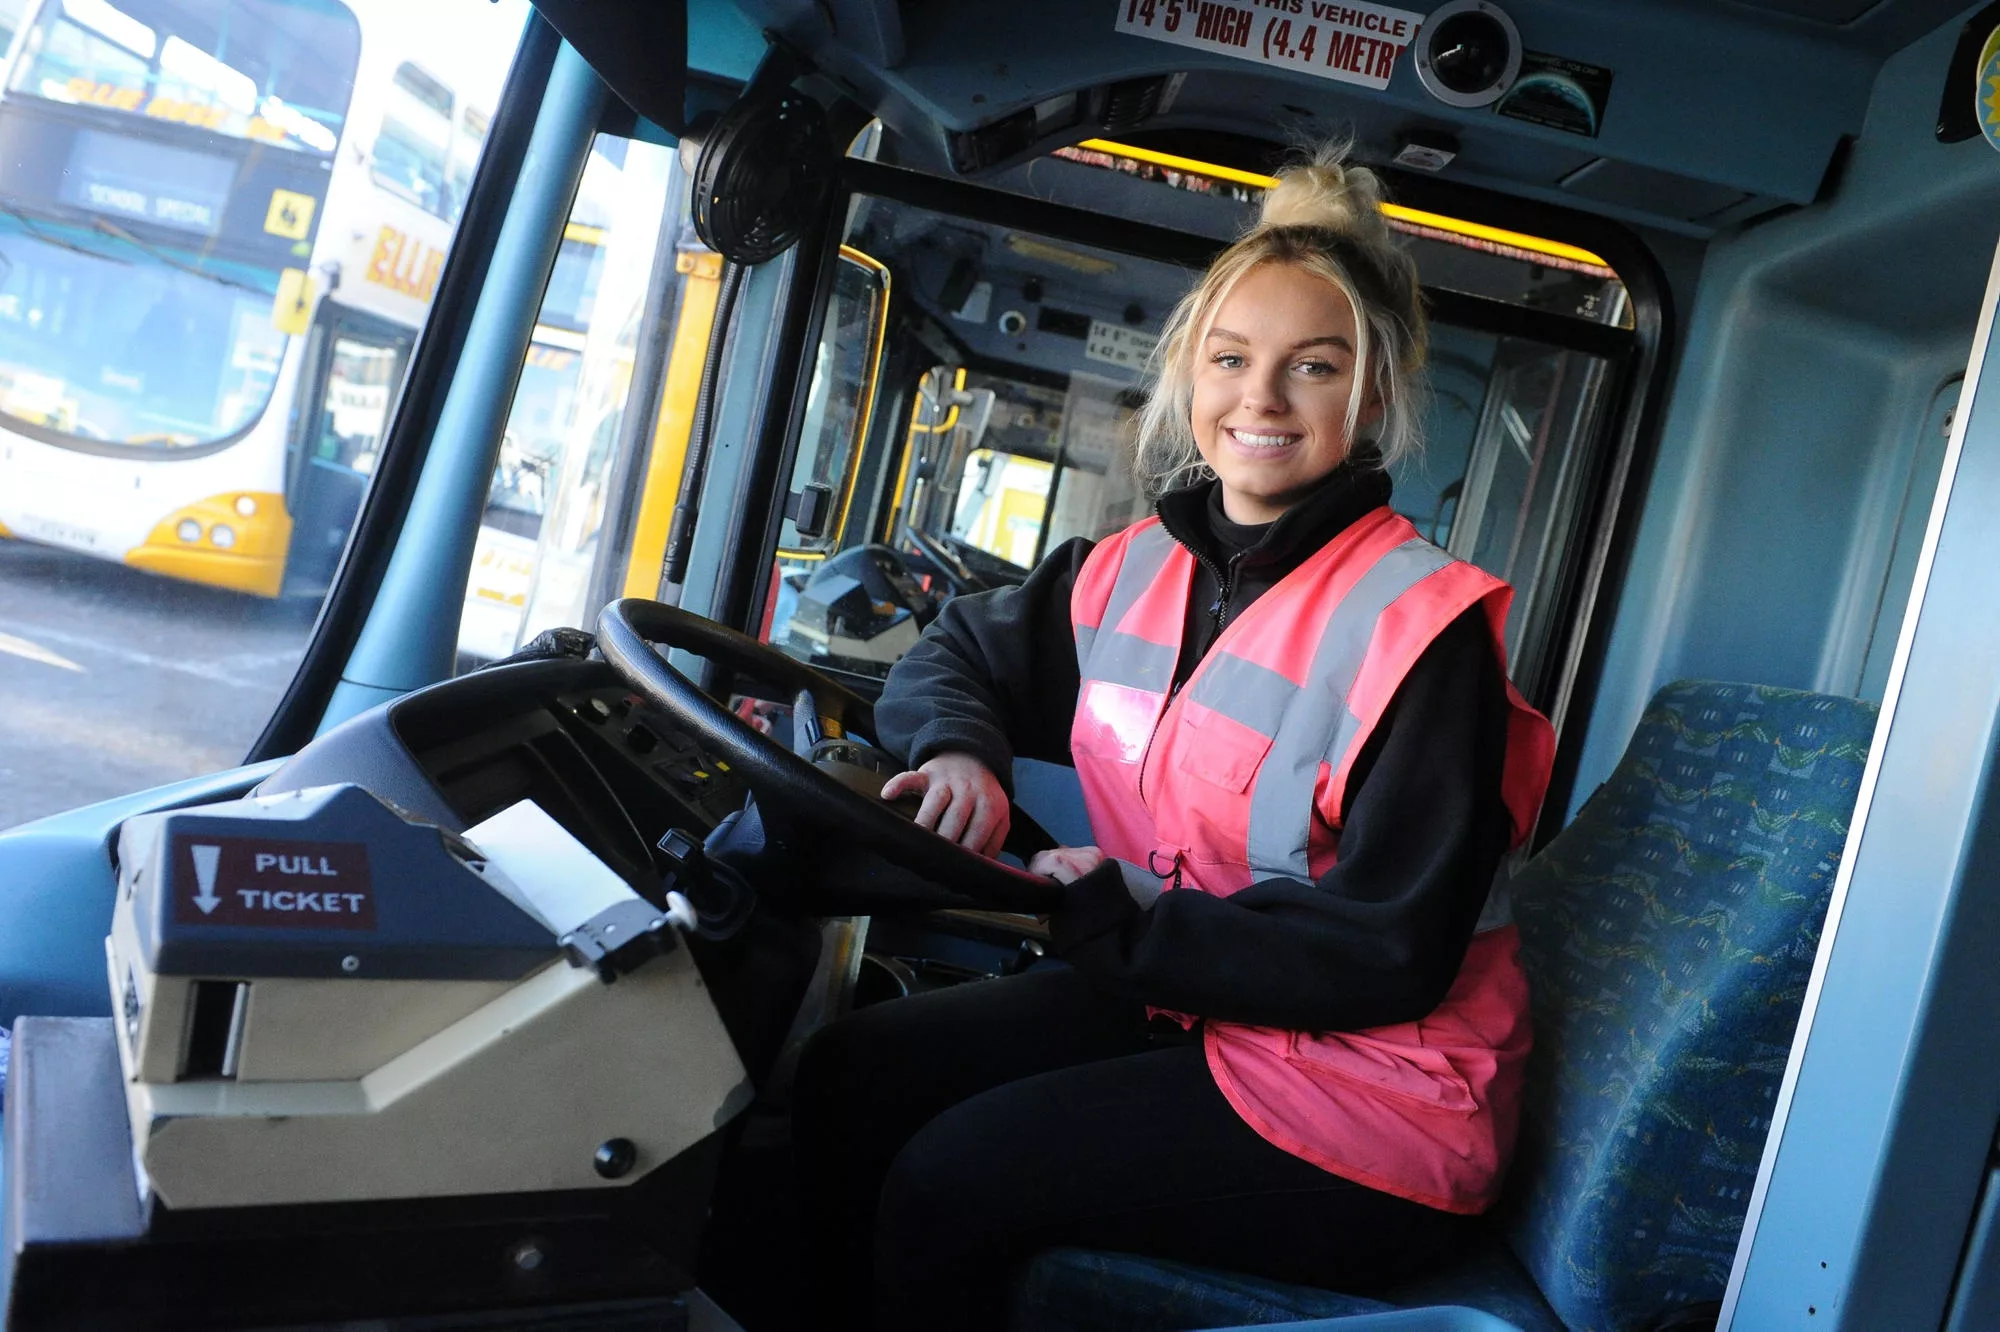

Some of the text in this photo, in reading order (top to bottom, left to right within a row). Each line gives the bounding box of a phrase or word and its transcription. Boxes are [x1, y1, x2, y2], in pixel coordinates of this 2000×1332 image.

[1311, 2, 1407, 37] VEHICLE
[1263, 17, 1318, 62] (4.4
[255, 853, 338, 877] PULL
[236, 889, 366, 914] TICKET
